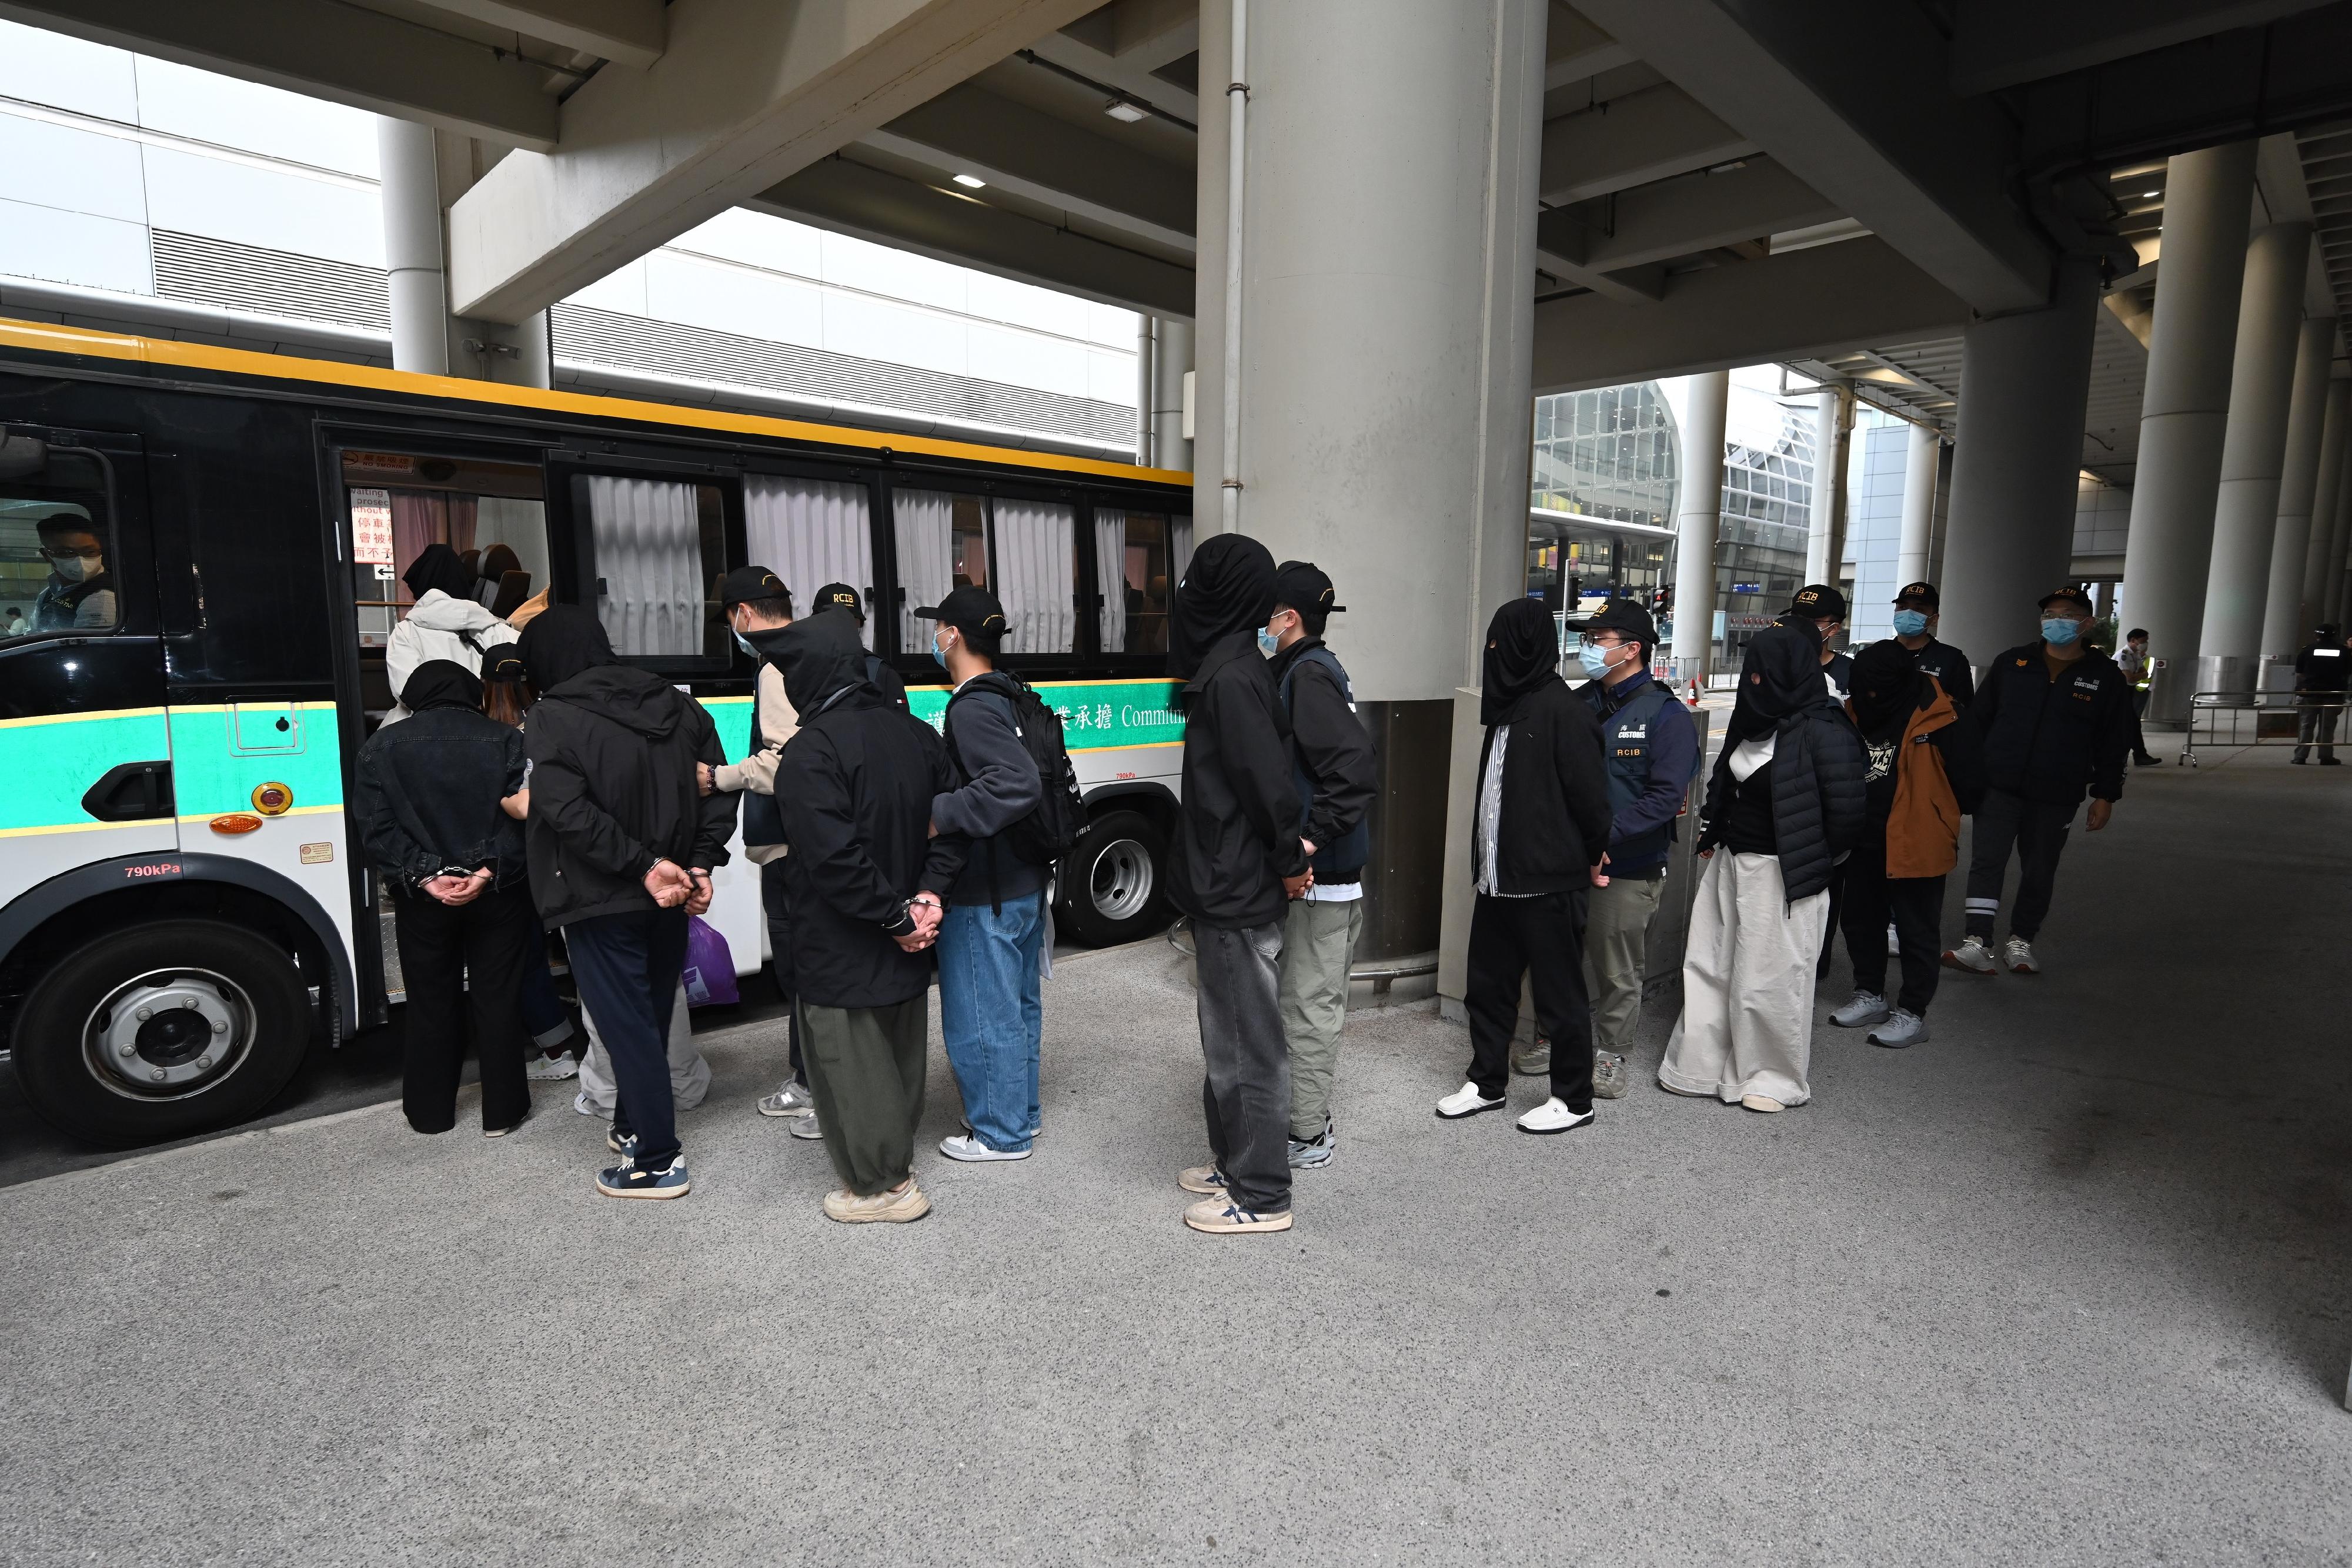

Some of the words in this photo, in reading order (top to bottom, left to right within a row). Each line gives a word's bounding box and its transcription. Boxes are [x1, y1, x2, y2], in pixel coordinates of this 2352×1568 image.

[1906, 586, 1925, 594] RCIB
[833, 593, 853, 603] RCIB
[1798, 591, 1818, 601] RCIB
[2074, 681, 2099, 691] CUSTOMS
[2073, 693, 2091, 701] RCIB
[125, 864, 181, 878] 790kPa
